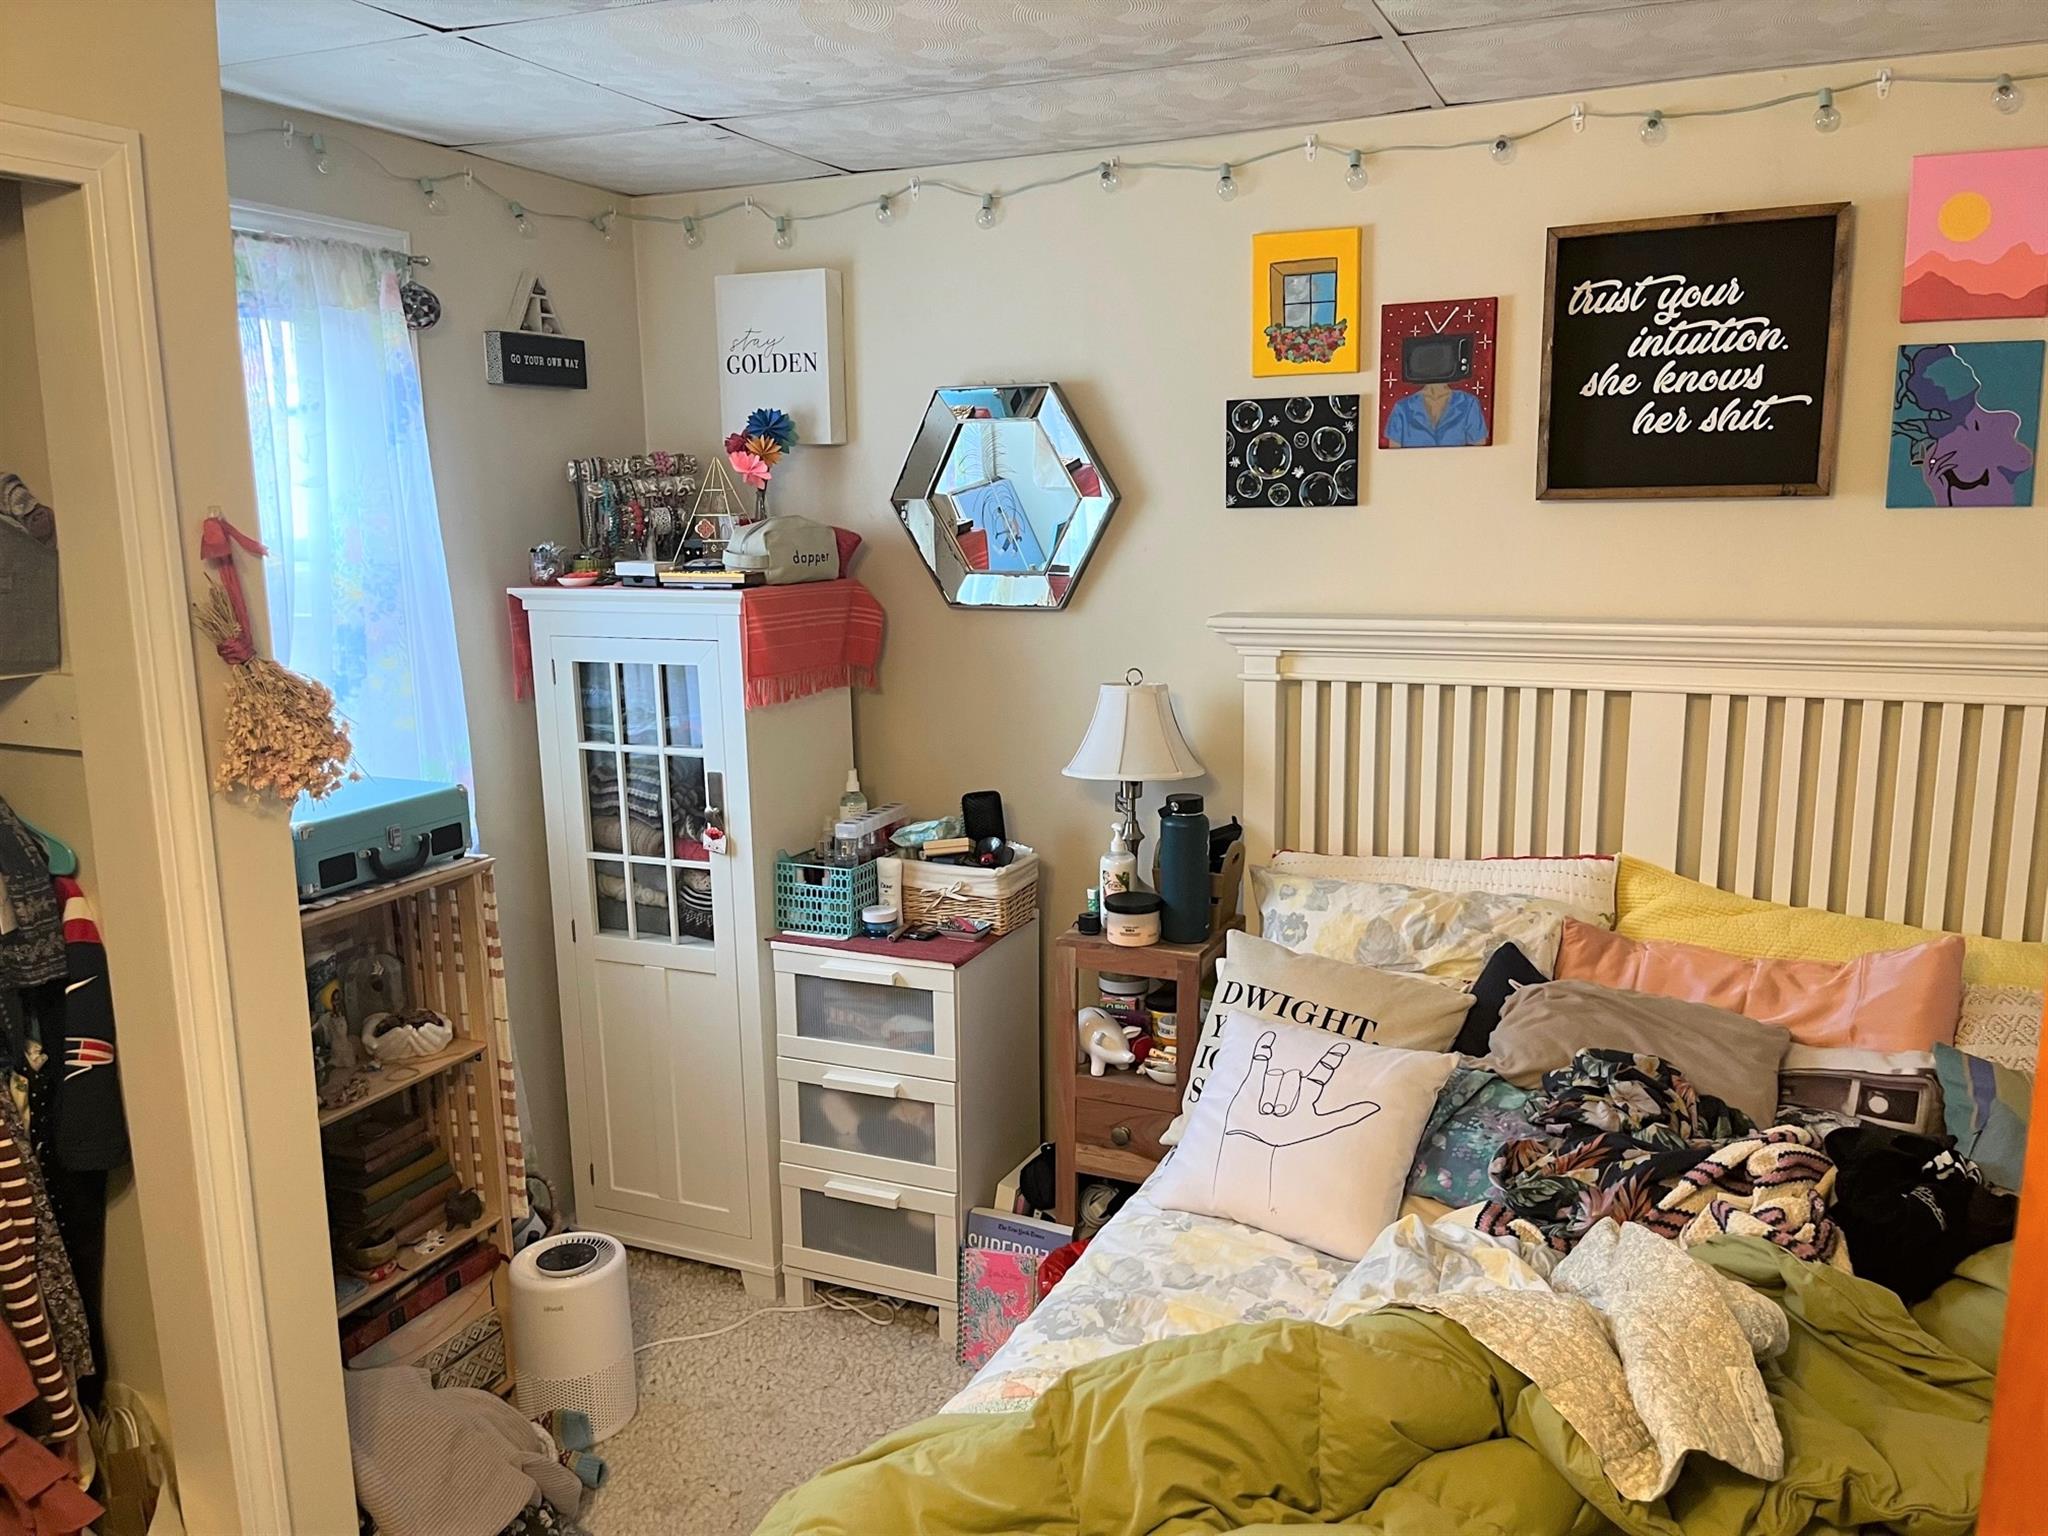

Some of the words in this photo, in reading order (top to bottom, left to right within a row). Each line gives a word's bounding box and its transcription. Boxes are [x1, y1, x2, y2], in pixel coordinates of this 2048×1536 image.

[1568, 275, 1686, 315] trust
[1653, 277, 1744, 325] your
[729, 327, 785, 358] stay
[1626, 316, 1789, 359] intuition.
[510, 353, 521, 365] GO
[523, 354, 545, 366] YOUR
[546, 356, 562, 368] OWN
[564, 358, 579, 369] WAY
[726, 351, 818, 375] GOLDEN
[1579, 362, 1642, 397] she
[1653, 360, 1765, 394] knows
[1632, 400, 1693, 434] her
[1698, 394, 1812, 433] shit.
[792, 550, 830, 567] dapper
